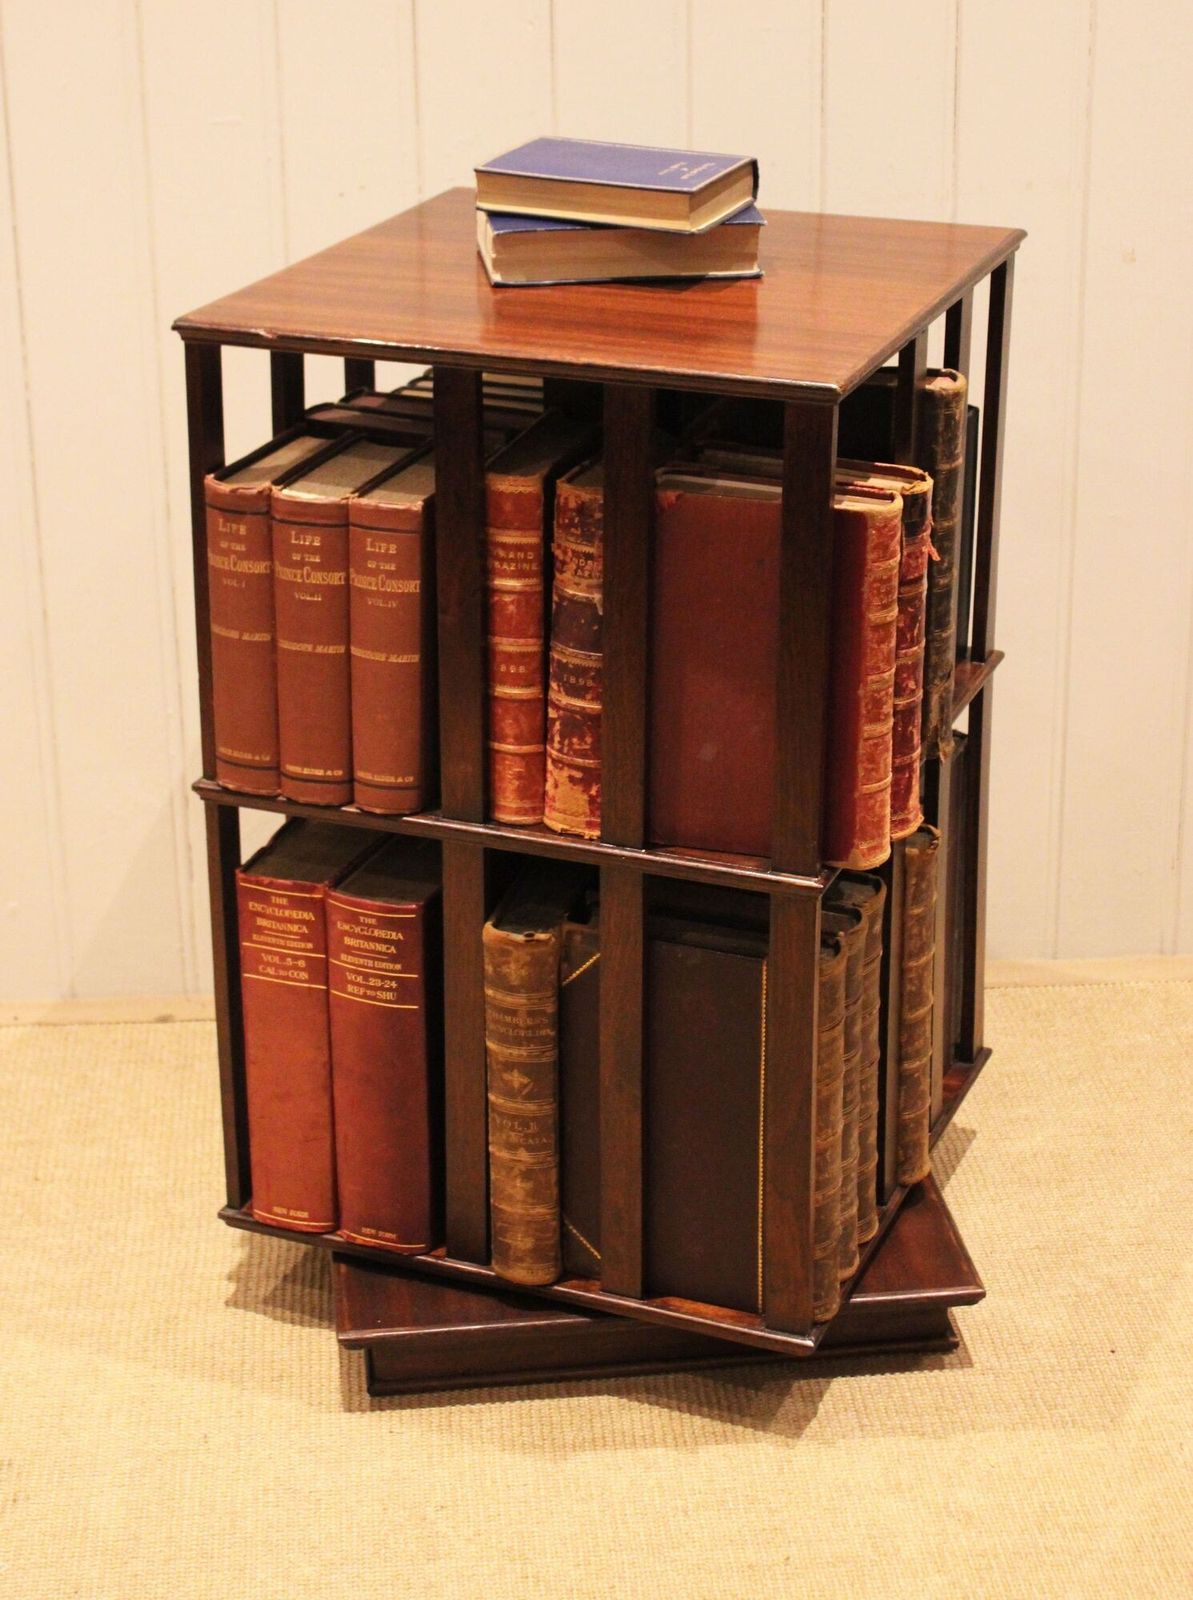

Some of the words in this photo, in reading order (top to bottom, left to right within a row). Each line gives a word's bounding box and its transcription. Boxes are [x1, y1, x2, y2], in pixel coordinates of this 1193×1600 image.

[291, 530, 321, 546] LIFE
[366, 538, 397, 554] LIFE
[230, 554, 272, 574] CONSORT
[303, 566, 346, 584] CONSORT
[378, 574, 421, 593] CONSORT
[271, 896, 289, 905] THE
[256, 917, 309, 934] BRITANNICA
[359, 915, 378, 925] THE
[343, 936, 397, 954] BRITANNICA
[376, 990, 398, 1001] SHU
